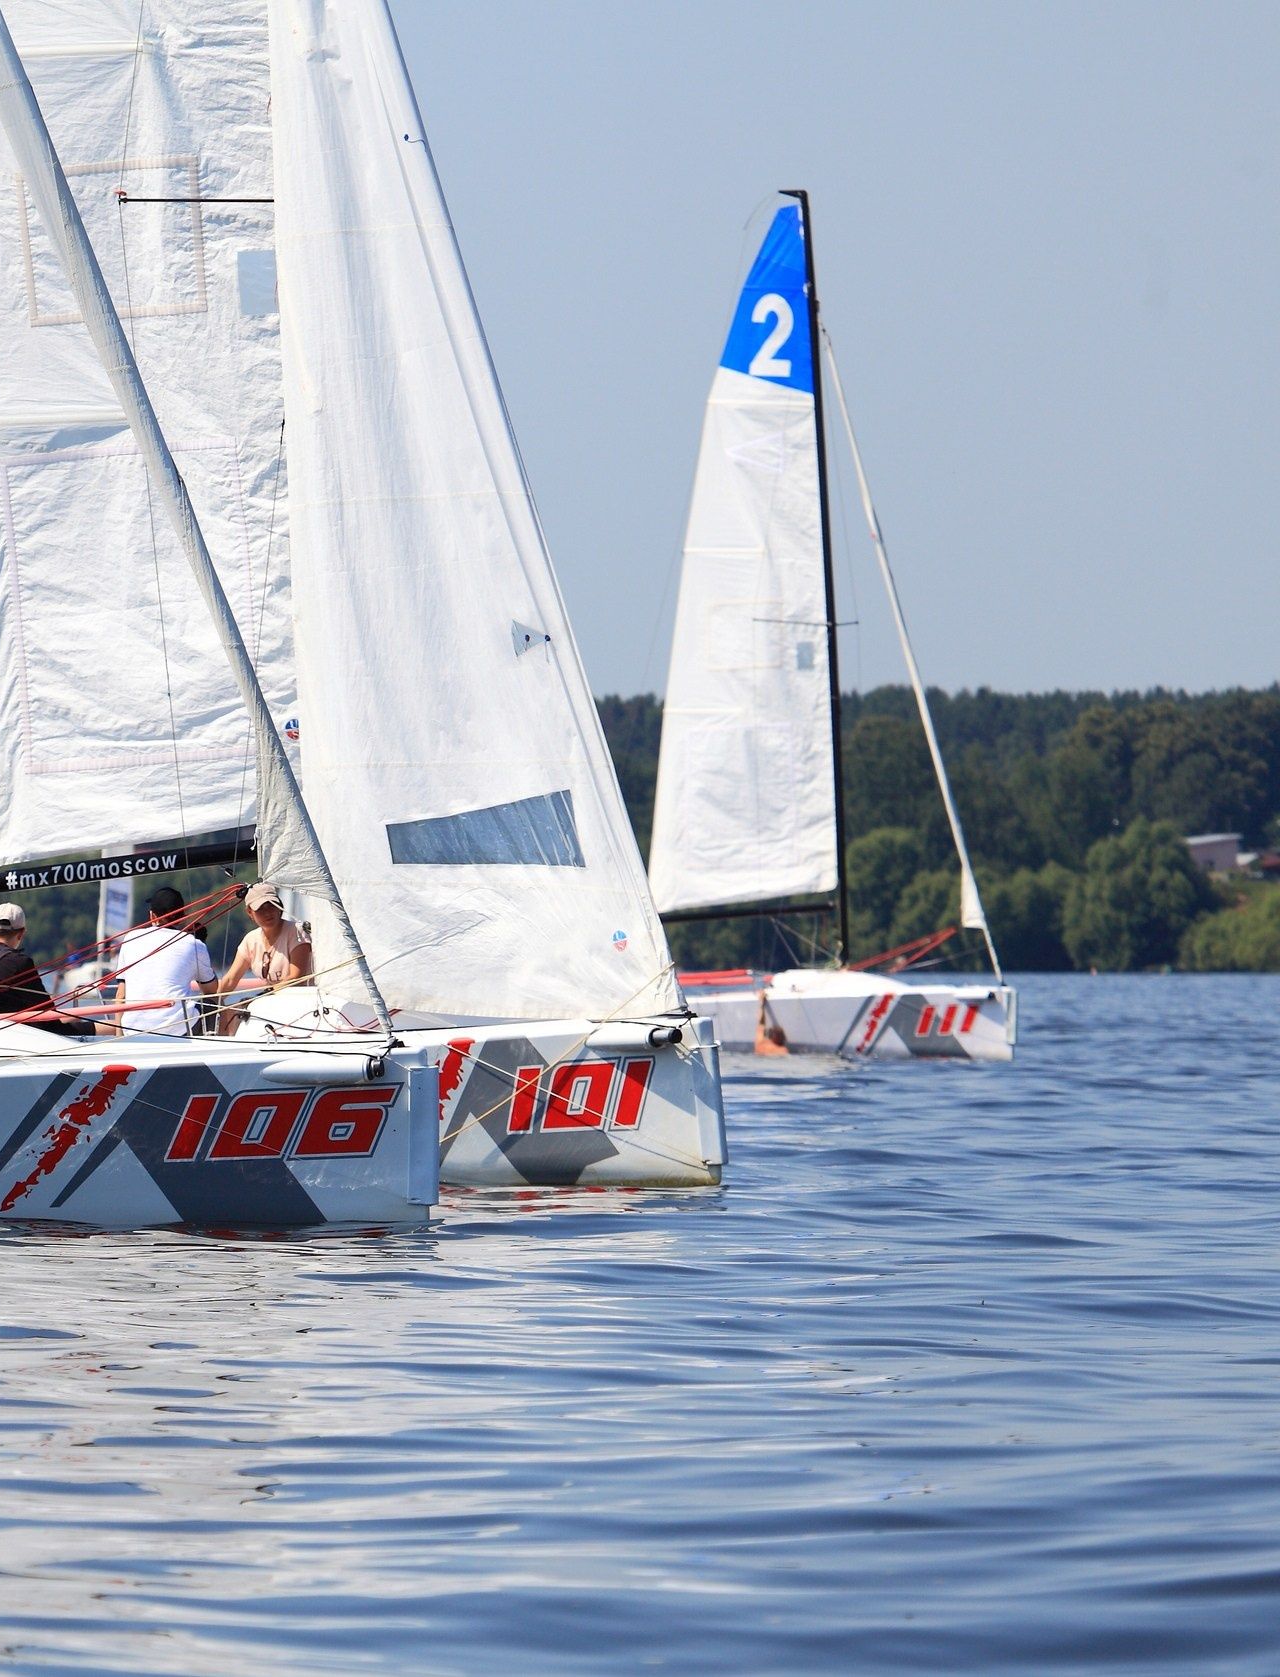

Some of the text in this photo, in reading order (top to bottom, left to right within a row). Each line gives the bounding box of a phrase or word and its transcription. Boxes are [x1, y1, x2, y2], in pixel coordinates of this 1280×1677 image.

[749, 293, 794, 378] 2
[5, 855, 177, 890] #mx700moscow
[916, 1005, 978, 1036] 111
[164, 1082, 404, 1162] 106
[507, 1055, 656, 1134] 101
